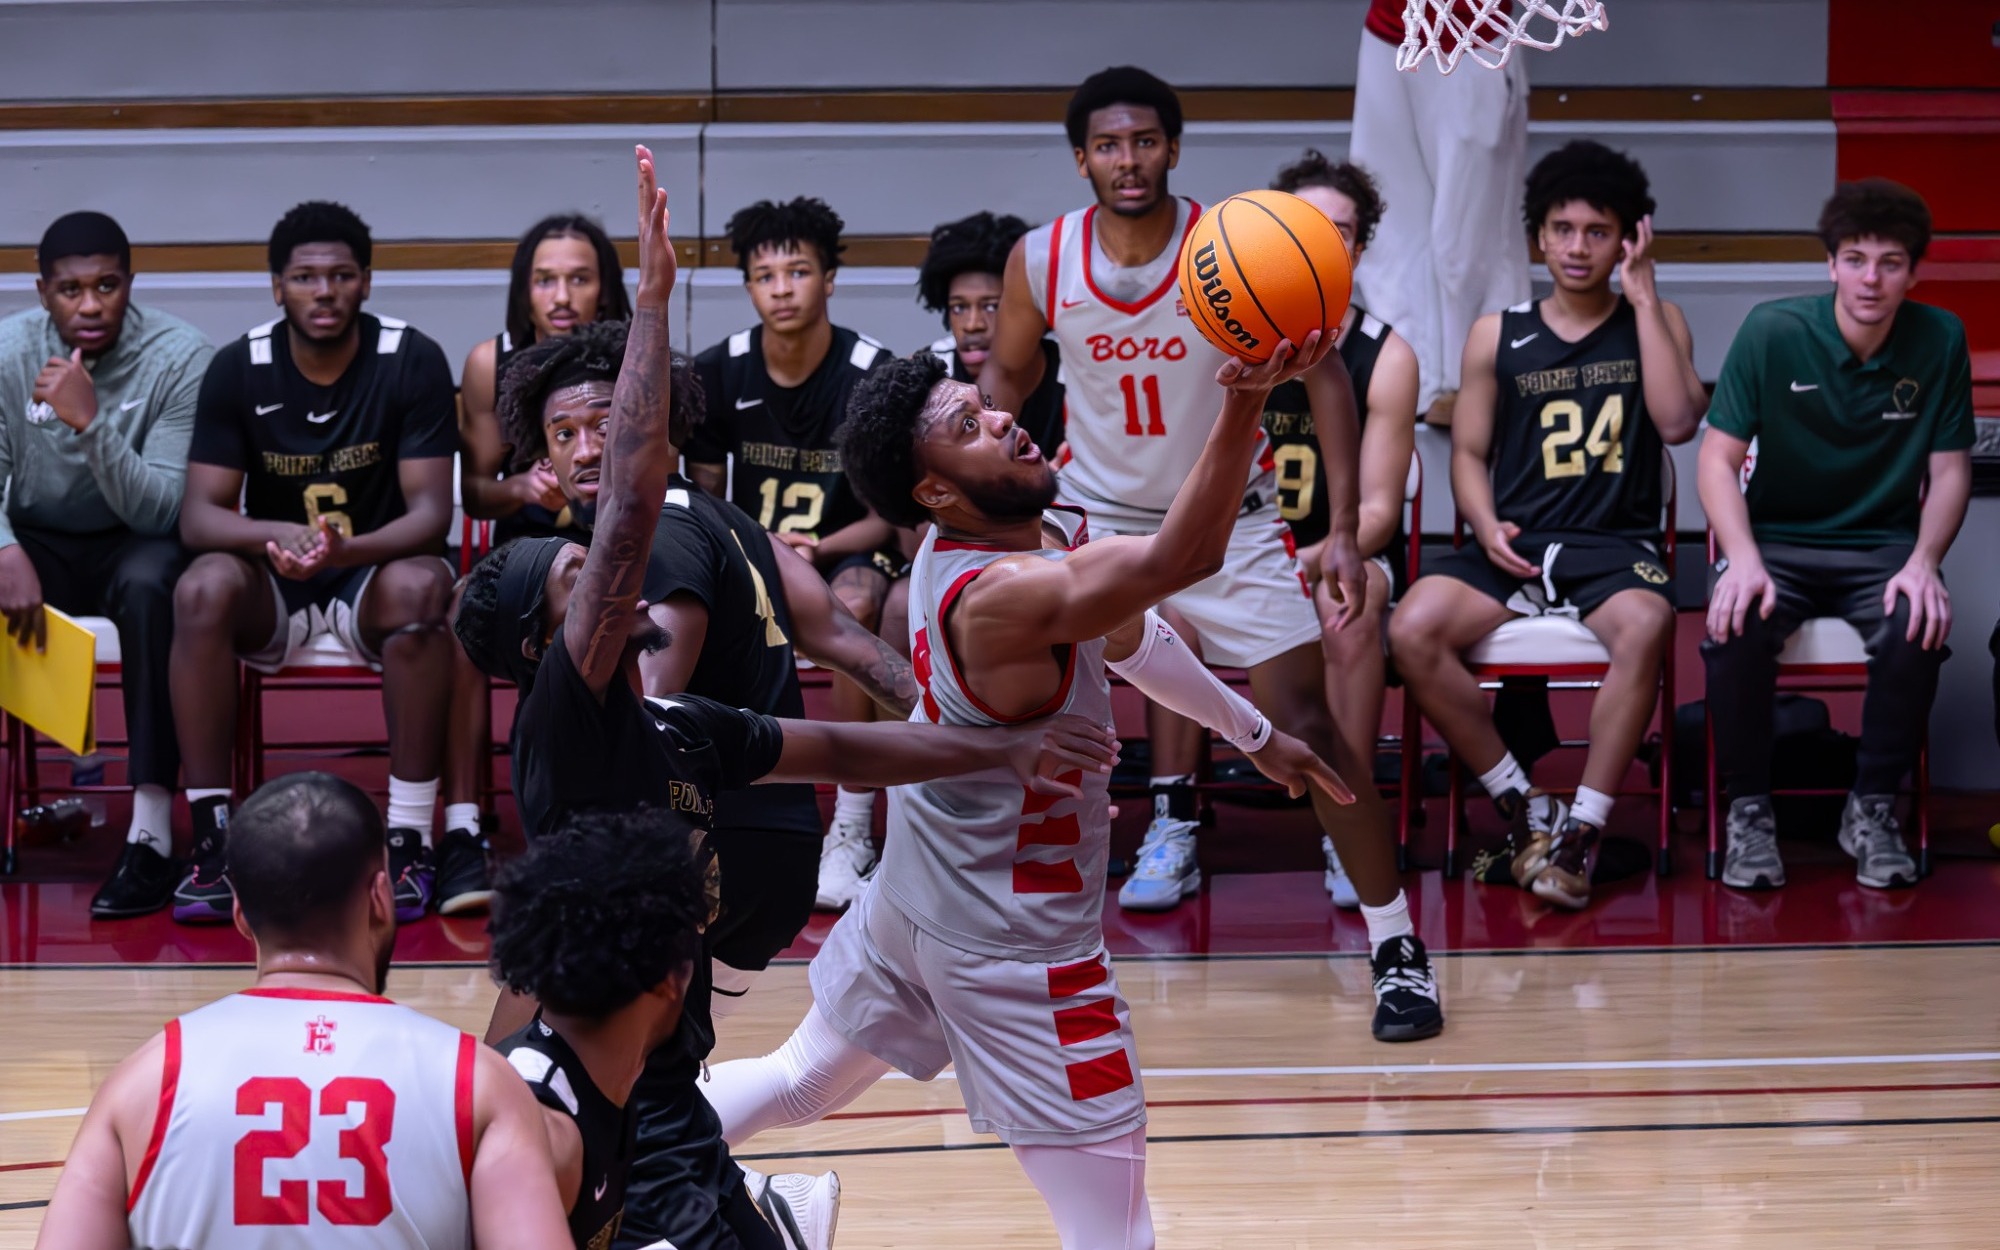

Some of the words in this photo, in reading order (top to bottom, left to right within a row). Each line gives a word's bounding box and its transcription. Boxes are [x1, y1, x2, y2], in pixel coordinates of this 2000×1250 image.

[1194, 239, 1260, 350] Wilson
[1085, 333, 1188, 362] Boro
[1119, 374, 1167, 436] 11
[1515, 367, 1578, 397] POINT
[1541, 394, 1624, 480] 24
[303, 483, 353, 537] 6
[759, 478, 825, 535] 12
[1273, 445, 1316, 521] 9
[669, 780, 713, 815] POIN
[234, 1076, 396, 1226] 23
